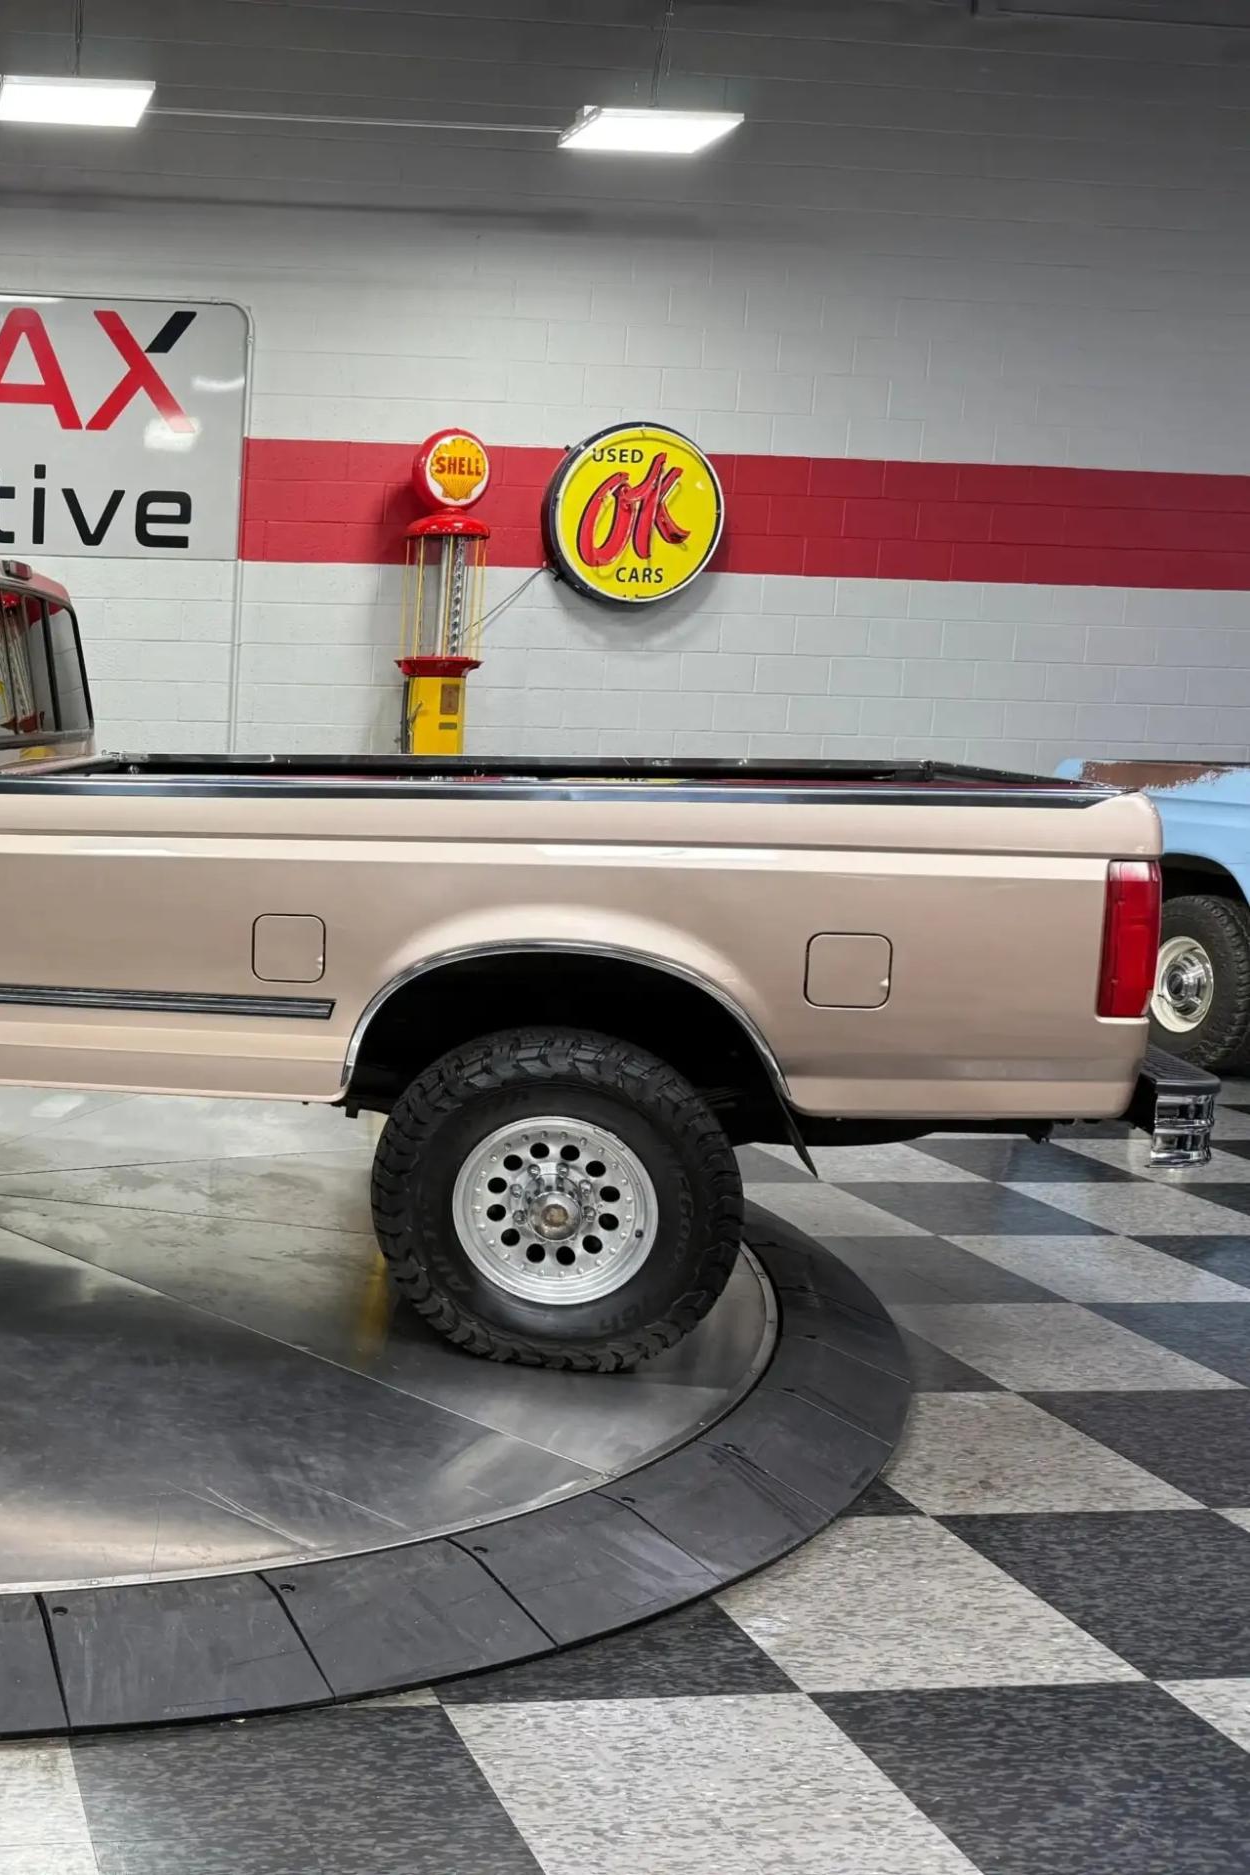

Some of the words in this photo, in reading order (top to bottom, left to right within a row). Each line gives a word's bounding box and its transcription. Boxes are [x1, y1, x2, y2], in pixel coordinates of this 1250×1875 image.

[592, 448, 644, 463] USED
[434, 455, 482, 477] SHELL
[576, 452, 691, 567] OK
[616, 567, 663, 583] CARS
